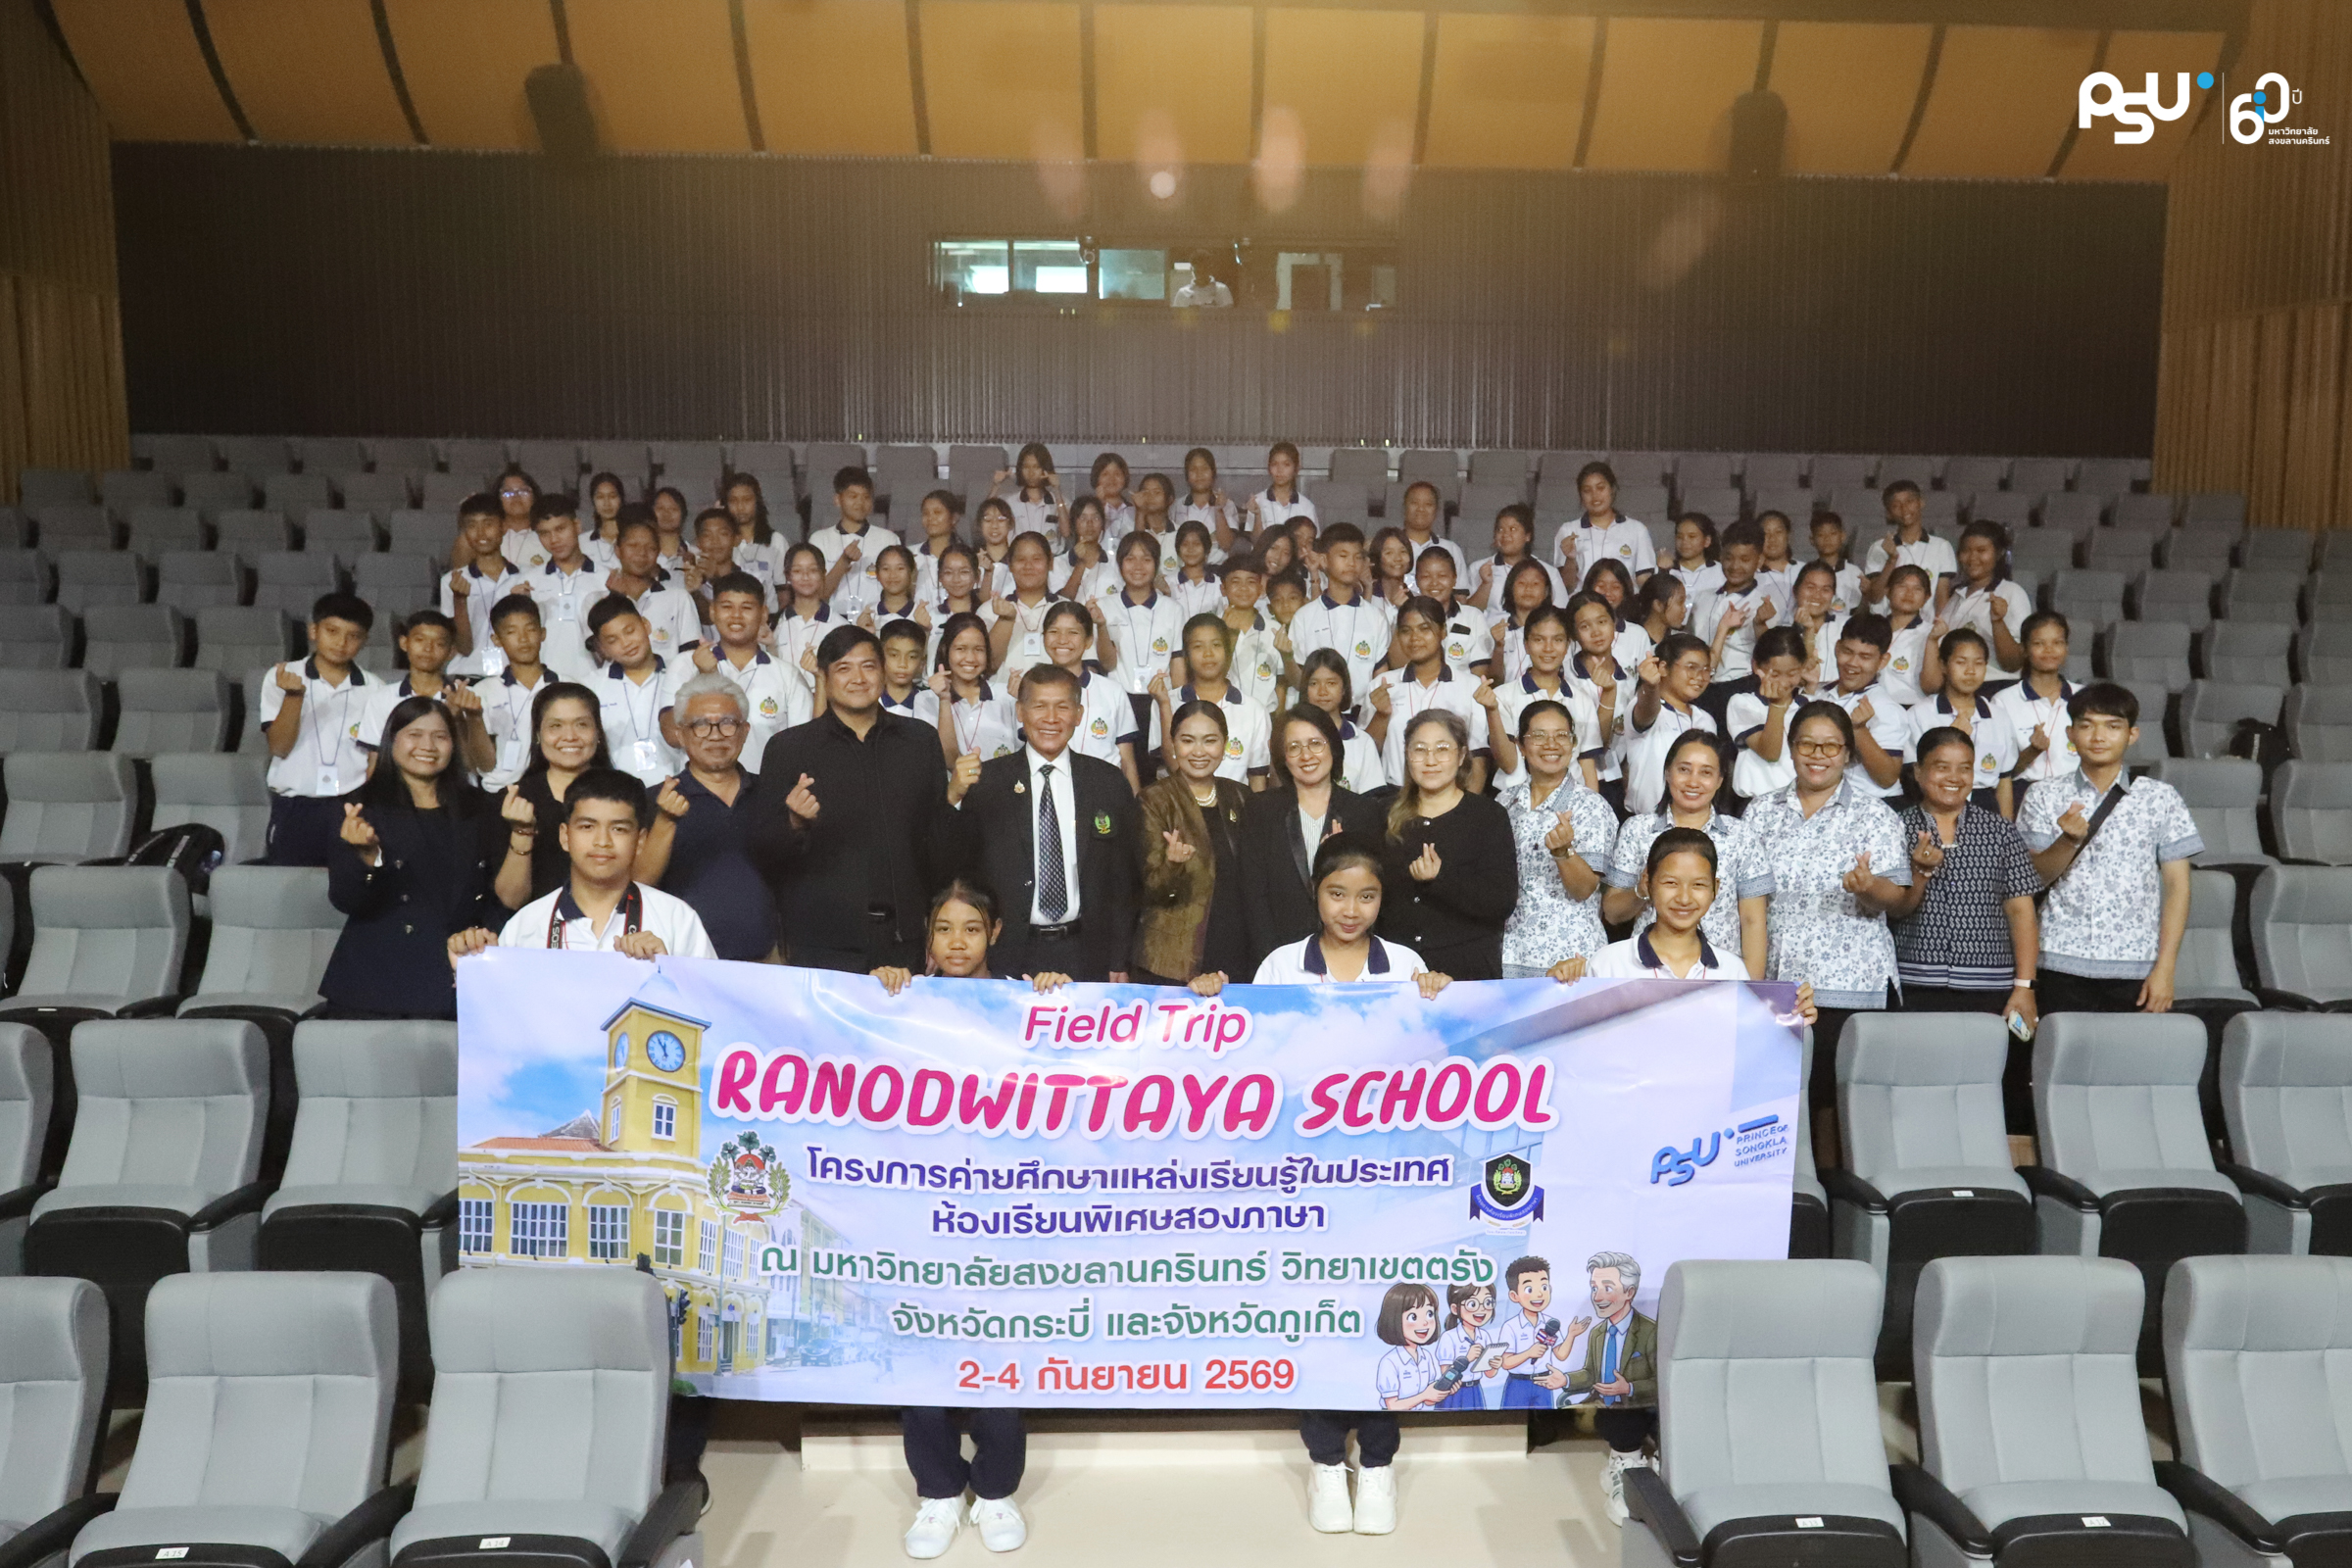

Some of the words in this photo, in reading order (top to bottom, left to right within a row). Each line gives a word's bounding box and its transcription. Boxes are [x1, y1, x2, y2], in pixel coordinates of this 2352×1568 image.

[1025, 1004, 1144, 1044] Field
[1157, 1004, 1247, 1053] Trip
[716, 1050, 1275, 1134] RANODWITTAYA
[1302, 1062, 1551, 1131] SCHOOL
[1735, 1136, 1788, 1156] SONGKLA
[1736, 1126, 1777, 1145] PRINCE
[1777, 1124, 1788, 1133] OF
[807, 1146, 1450, 1194] โครงการค่ายศึกษาแหล่งเรียนรู้ในประเทศ
[1734, 1147, 1788, 1167] UNIVERSITY
[932, 1200, 1325, 1234] ห้องเรียนพิเศษสองภาษา
[761, 1247, 797, 1272] ณ
[812, 1250, 1267, 1287] มหาวิทยาลัยสงขลานครินทร์
[1282, 1249, 1494, 1283] วิทยาเขตตรัง
[891, 1297, 1091, 1340] จังหวัดกระบี่
[1106, 1298, 1361, 1343] และจังหวัดภูเก็ต
[958, 1360, 1020, 1390] 2-4
[1038, 1356, 1187, 1391] กันยายน
[1204, 1358, 1296, 1390] 2569
